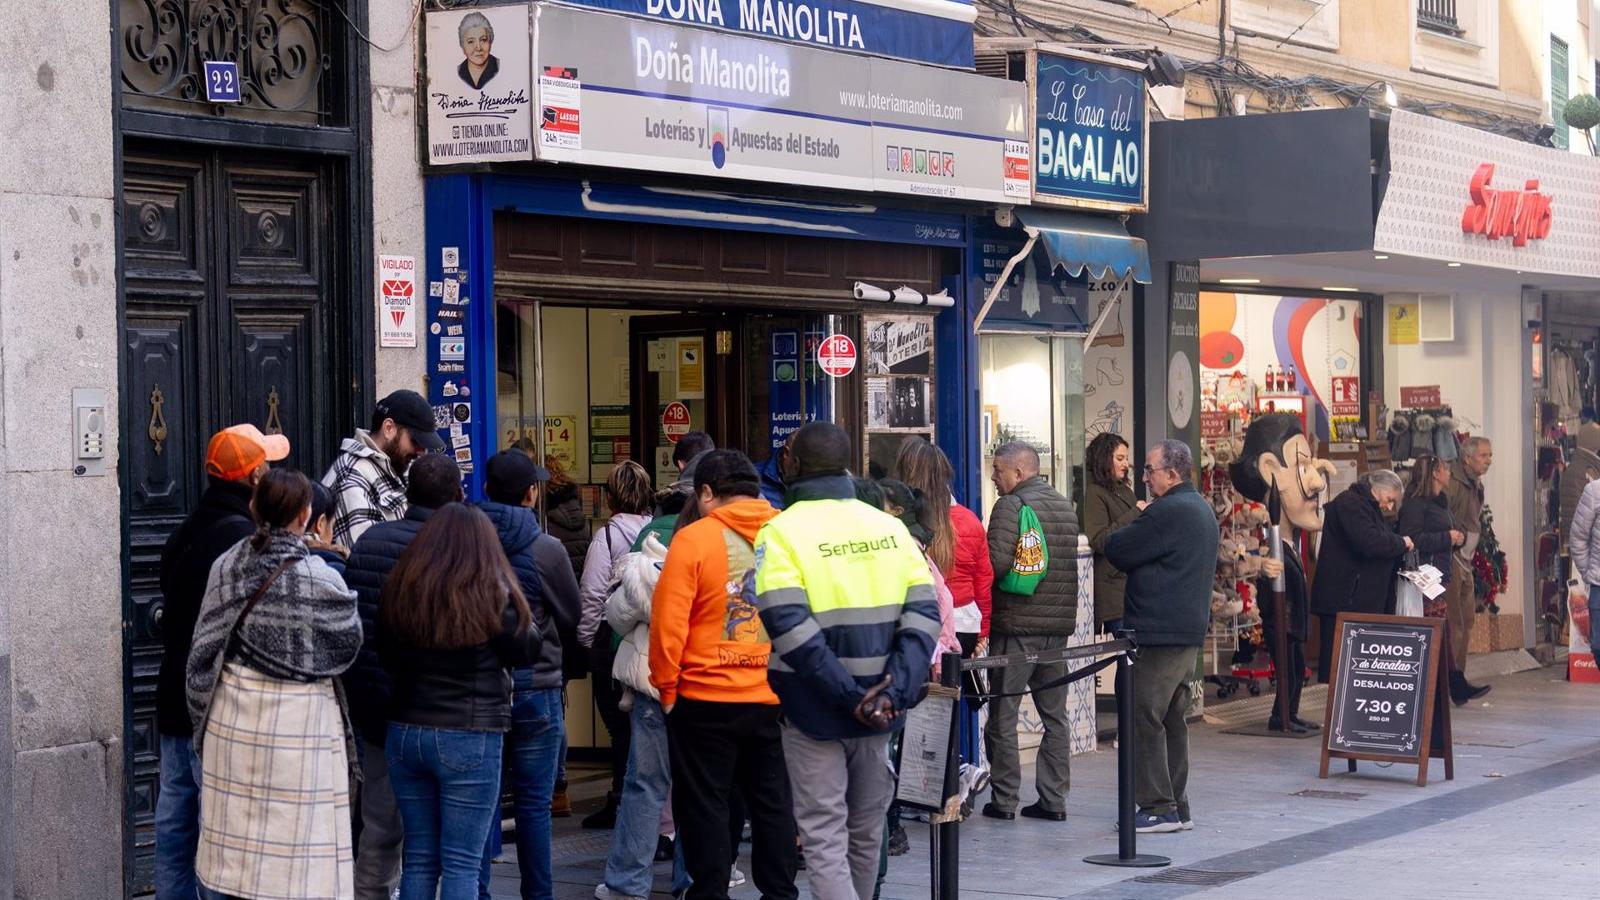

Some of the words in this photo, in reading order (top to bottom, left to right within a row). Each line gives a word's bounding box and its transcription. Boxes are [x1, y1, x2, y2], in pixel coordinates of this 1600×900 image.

[739, 0, 865, 48] MANOLITA
[636, 37, 694, 84] Doña
[699, 46, 791, 97] Manolita
[211, 70, 233, 93] 22
[839, 89, 964, 121] www.loteriamanolita.com
[1046, 80, 1069, 122] La
[1072, 83, 1105, 127] Casa
[1110, 94, 1133, 131] del
[460, 125, 483, 139] TIENDA
[645, 116, 696, 143] Loterías
[698, 127, 706, 150] y
[732, 130, 784, 153] Apuestas
[785, 135, 802, 154] del
[804, 139, 841, 159] Estado
[1038, 128, 1139, 187] BACALAO
[380, 259, 414, 270] VIGILADO
[667, 406, 684, 420] +18
[1360, 643, 1413, 657] LOMOS
[1370, 657, 1411, 672] bacalao
[1353, 679, 1415, 692] DESALADOS
[1355, 698, 1392, 714] 7,30
[1395, 702, 1407, 715] €
